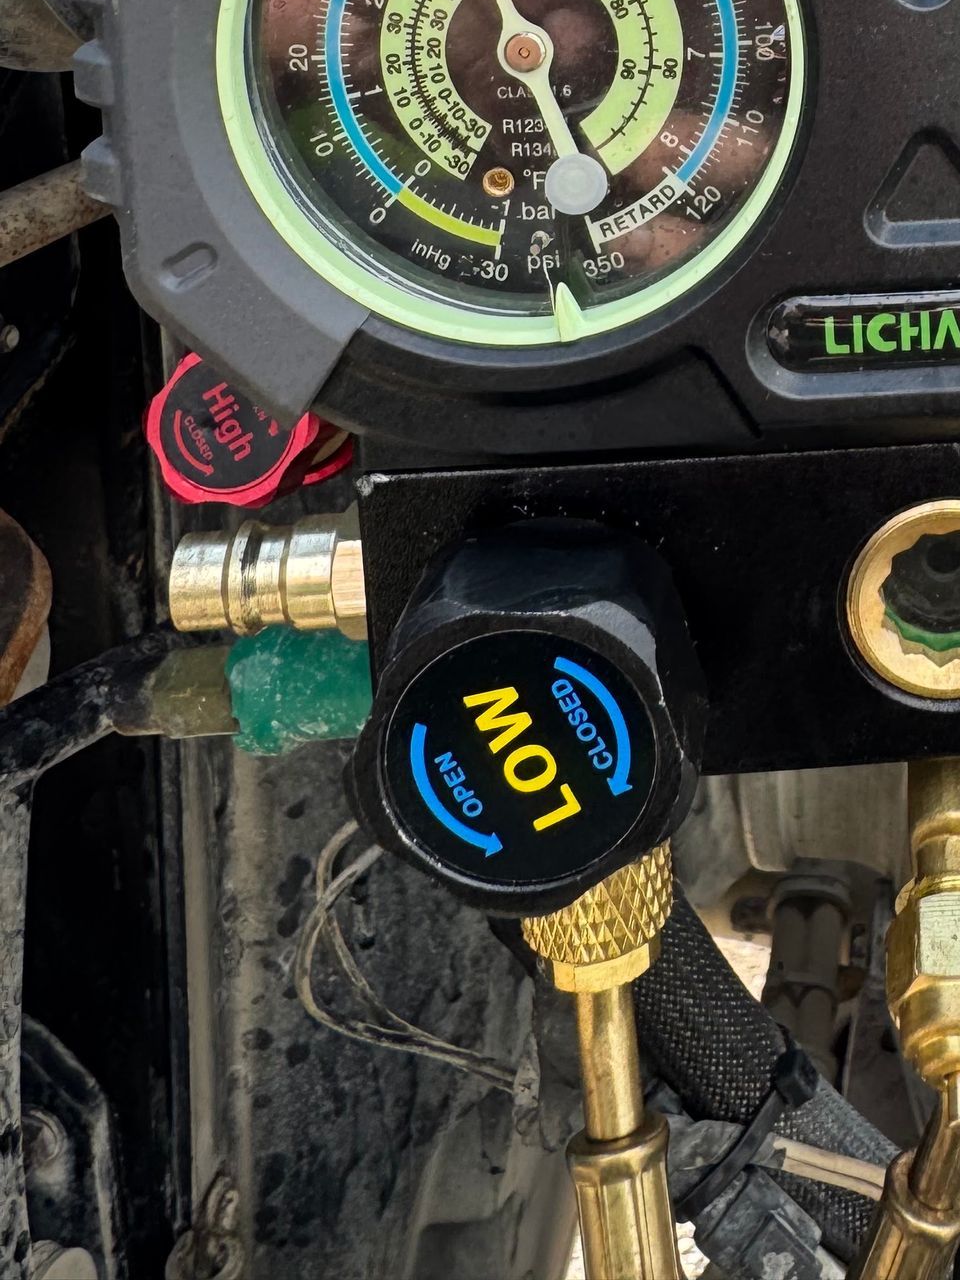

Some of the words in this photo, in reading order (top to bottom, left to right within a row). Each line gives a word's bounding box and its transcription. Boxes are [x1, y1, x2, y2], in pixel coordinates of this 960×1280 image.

[426, 37, 441, 59] 20
[755, 22, 774, 60] 100
[289, 44, 308, 71] 20
[385, 53, 402, 75] 20
[687, 47, 705, 61] 7
[428, 62, 446, 84] 10
[365, 85, 383, 97] 1
[393, 86, 411, 108] 10
[438, 87, 452, 100] 0
[497, 86, 535, 99] CLA
[408, 117, 423, 131] 0
[502, 118, 547, 134] R123
[737, 110, 765, 147] 110
[310, 132, 334, 157] 10
[511, 143, 556, 157] R134
[660, 131, 679, 148] 8
[415, 159, 432, 176] 0
[599, 184, 676, 238] RETARD
[686, 185, 721, 220] 120
[369, 207, 387, 224] 0
[411, 238, 451, 270] inHg
[527, 250, 561, 274] psi
[583, 251, 625, 278] 350
[202, 381, 254, 462] High
[184, 415, 214, 460] CLOSED
[551, 678, 613, 770] CLOSED
[462, 686, 582, 832] LOW
[433, 751, 484, 818] OPEN
